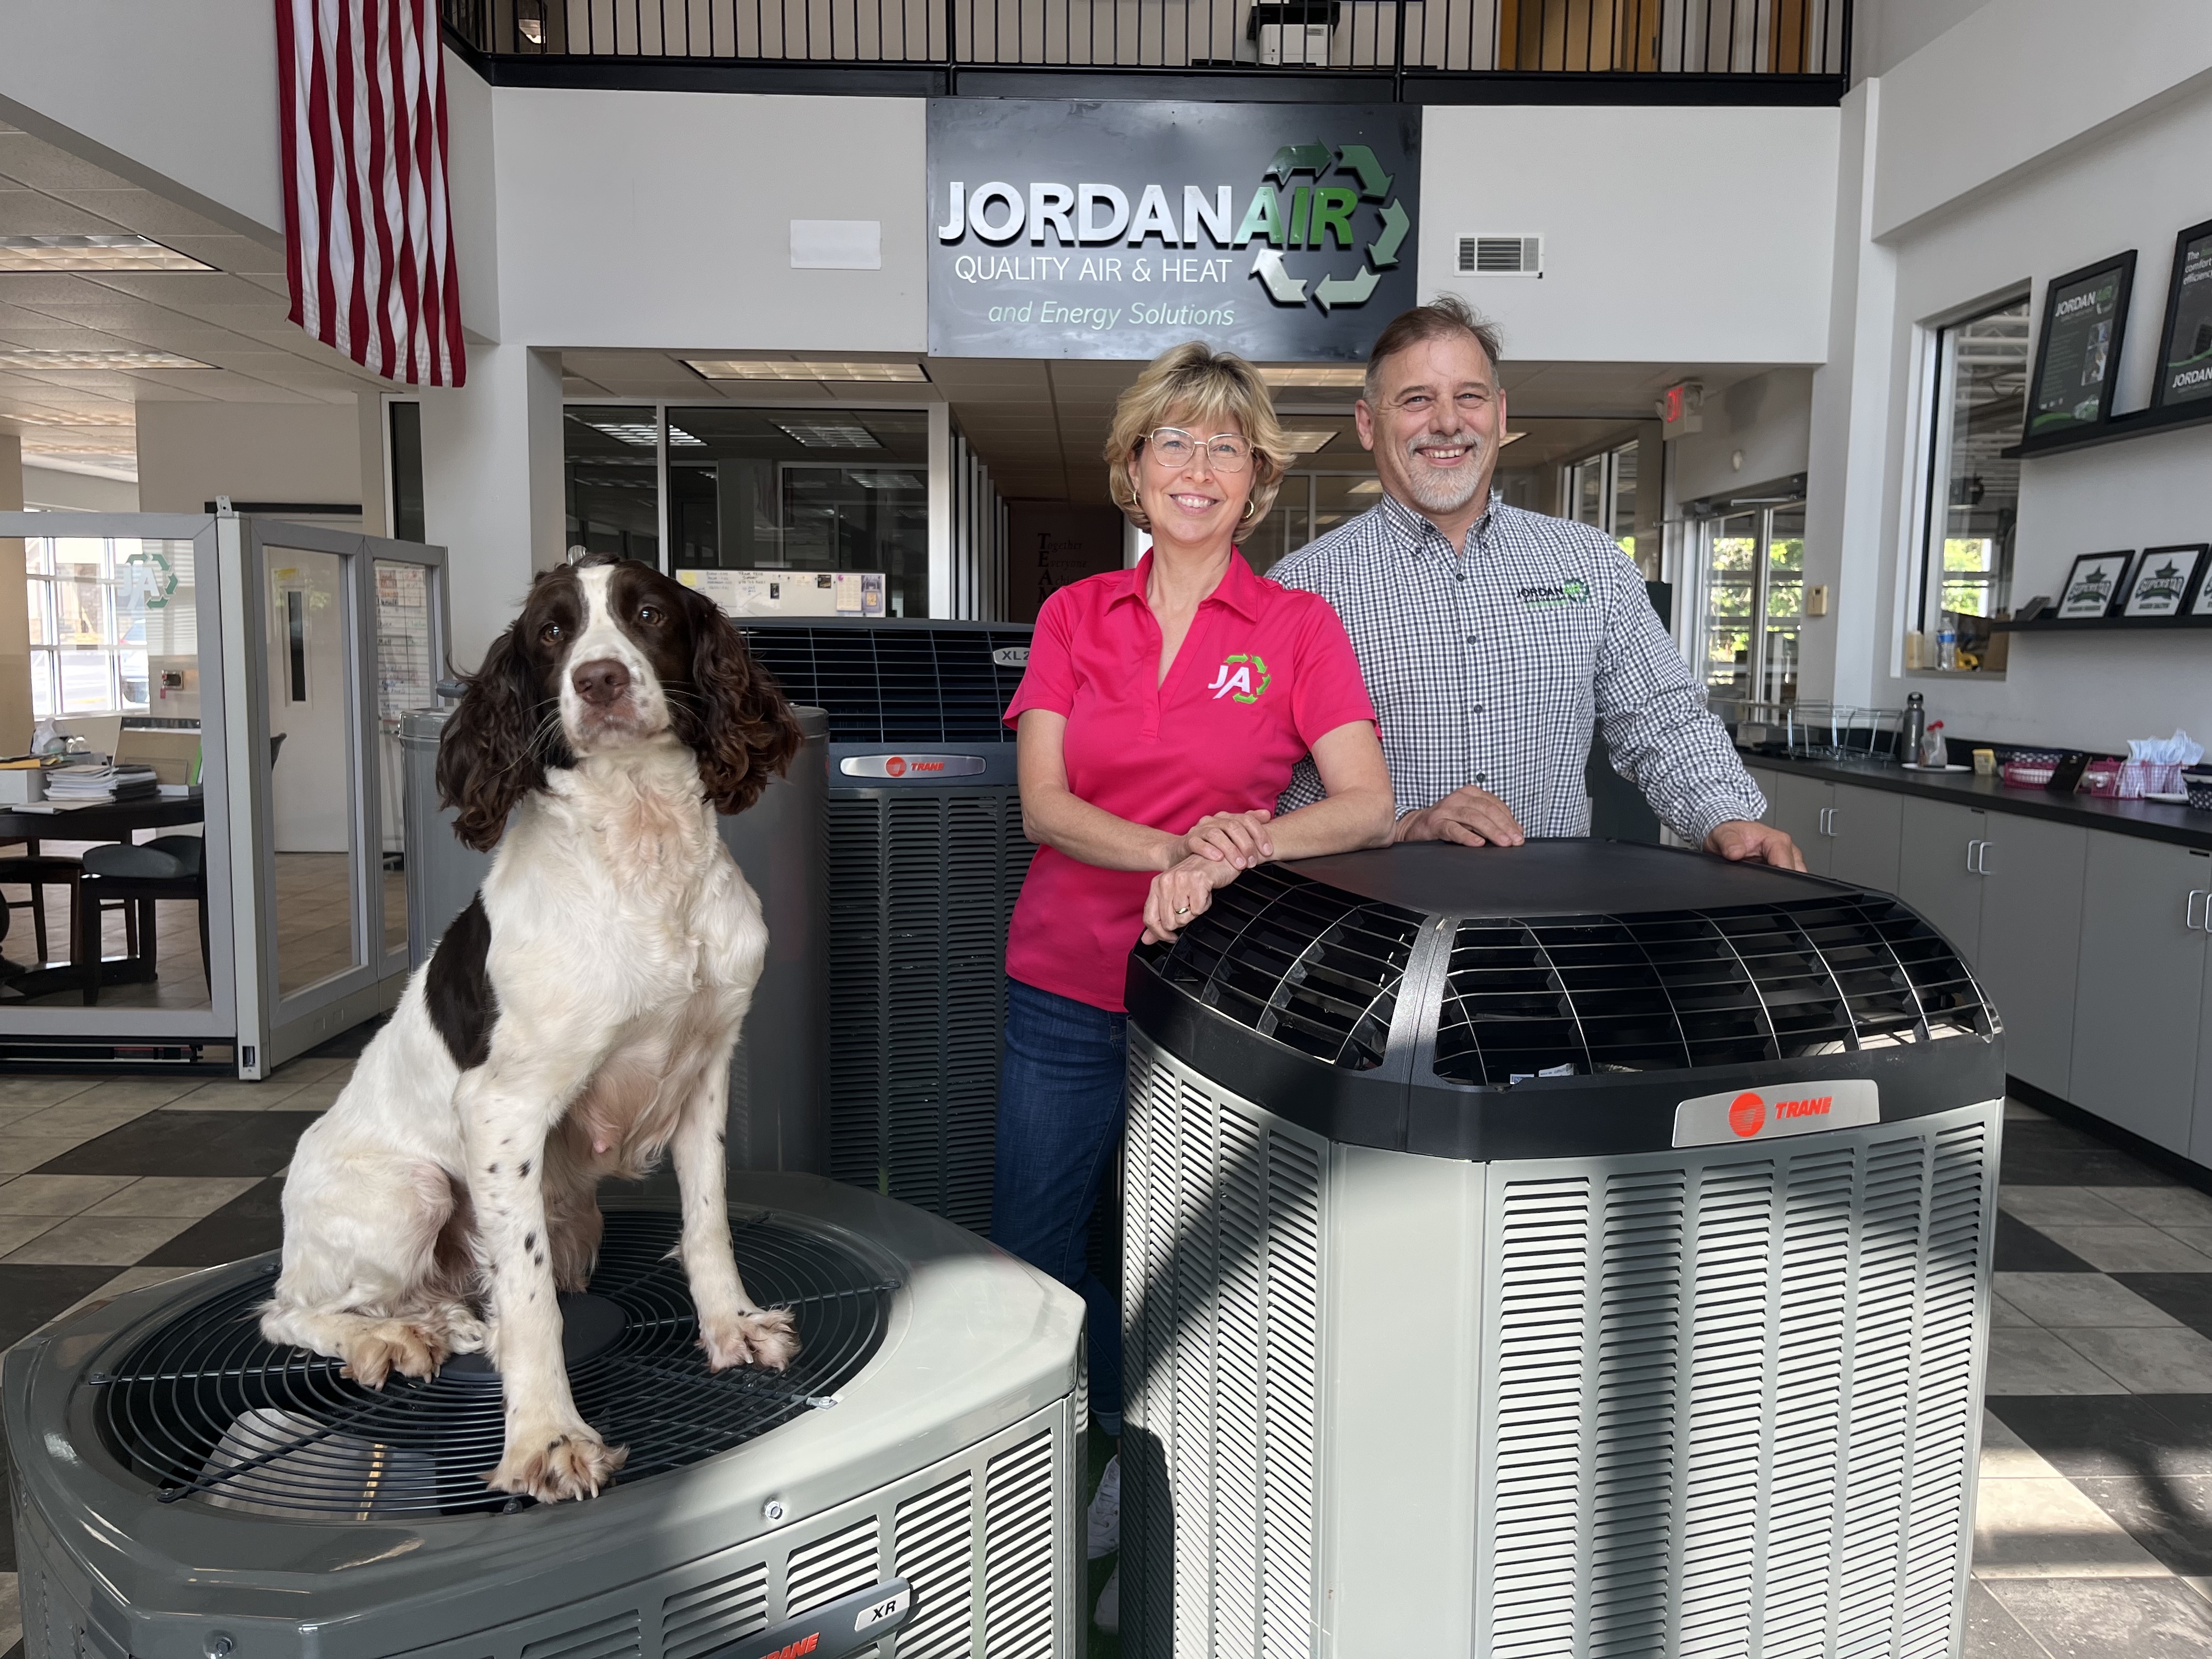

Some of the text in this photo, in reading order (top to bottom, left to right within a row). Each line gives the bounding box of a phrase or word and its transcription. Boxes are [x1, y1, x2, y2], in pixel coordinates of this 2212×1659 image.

[955, 255, 1233, 284] QUALITY AIR & HEAT
[988, 302, 1235, 331] and Energy Solutions
[1037, 533, 1084, 553] Together
[1037, 551, 1088, 571] Everyone
[1037, 569, 1073, 586] Achi
[1002, 651, 1030, 661] XL2
[1207, 665, 1250, 699] JA
[911, 762, 945, 772] TRANE
[1775, 1096, 1833, 1120] TRANE
[871, 1599, 897, 1623] XR
[760, 1632, 820, 1659] RANE
